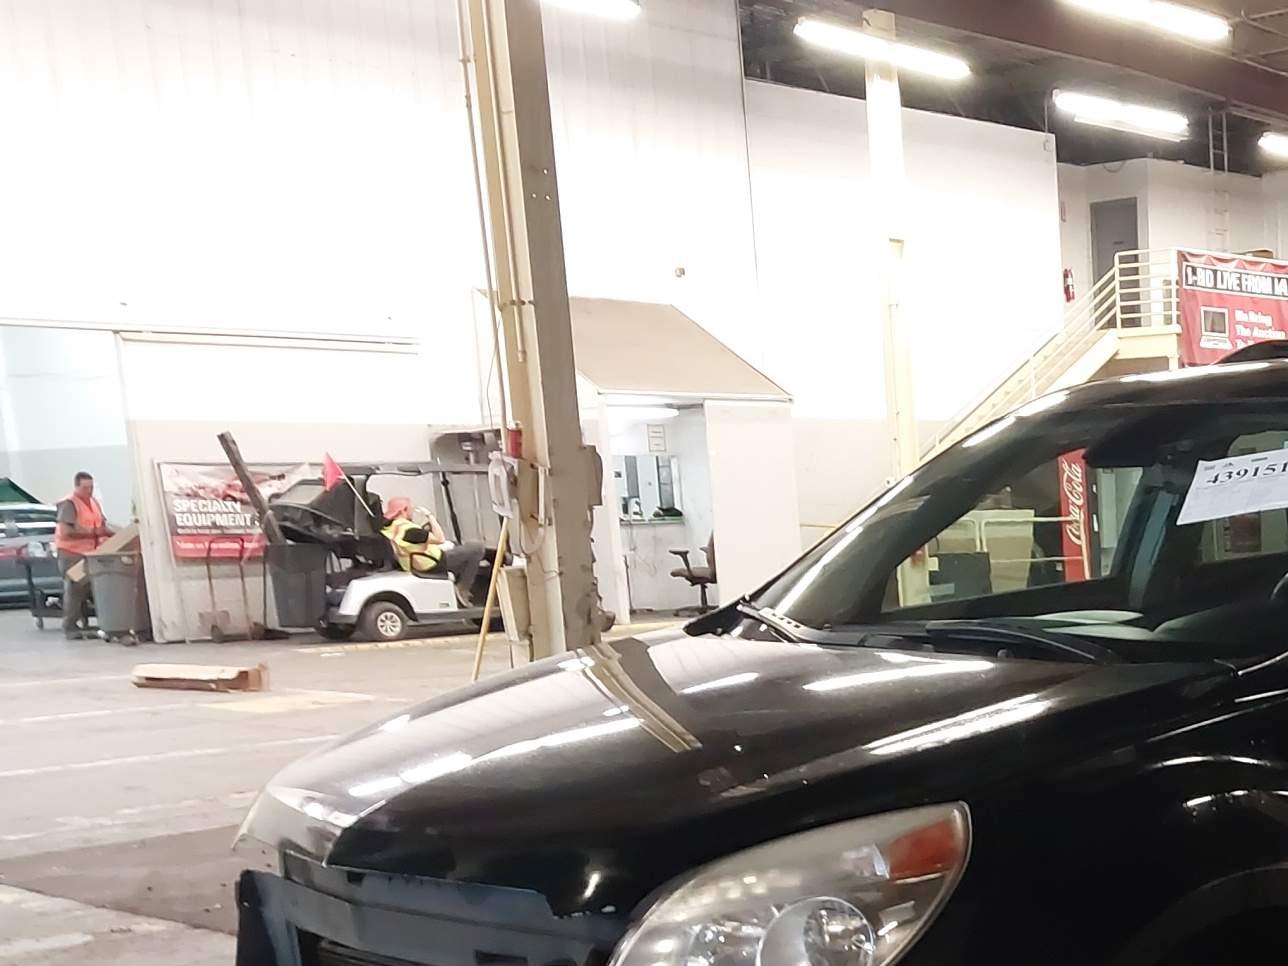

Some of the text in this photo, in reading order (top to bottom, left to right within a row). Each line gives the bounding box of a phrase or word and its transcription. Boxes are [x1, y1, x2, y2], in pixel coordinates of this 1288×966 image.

[1217, 271, 1240, 291] LIVE
[1241, 274, 1272, 294] FROM
[173, 500, 241, 513] SPECIALTY
[175, 513, 251, 526] EQUIPMENT
